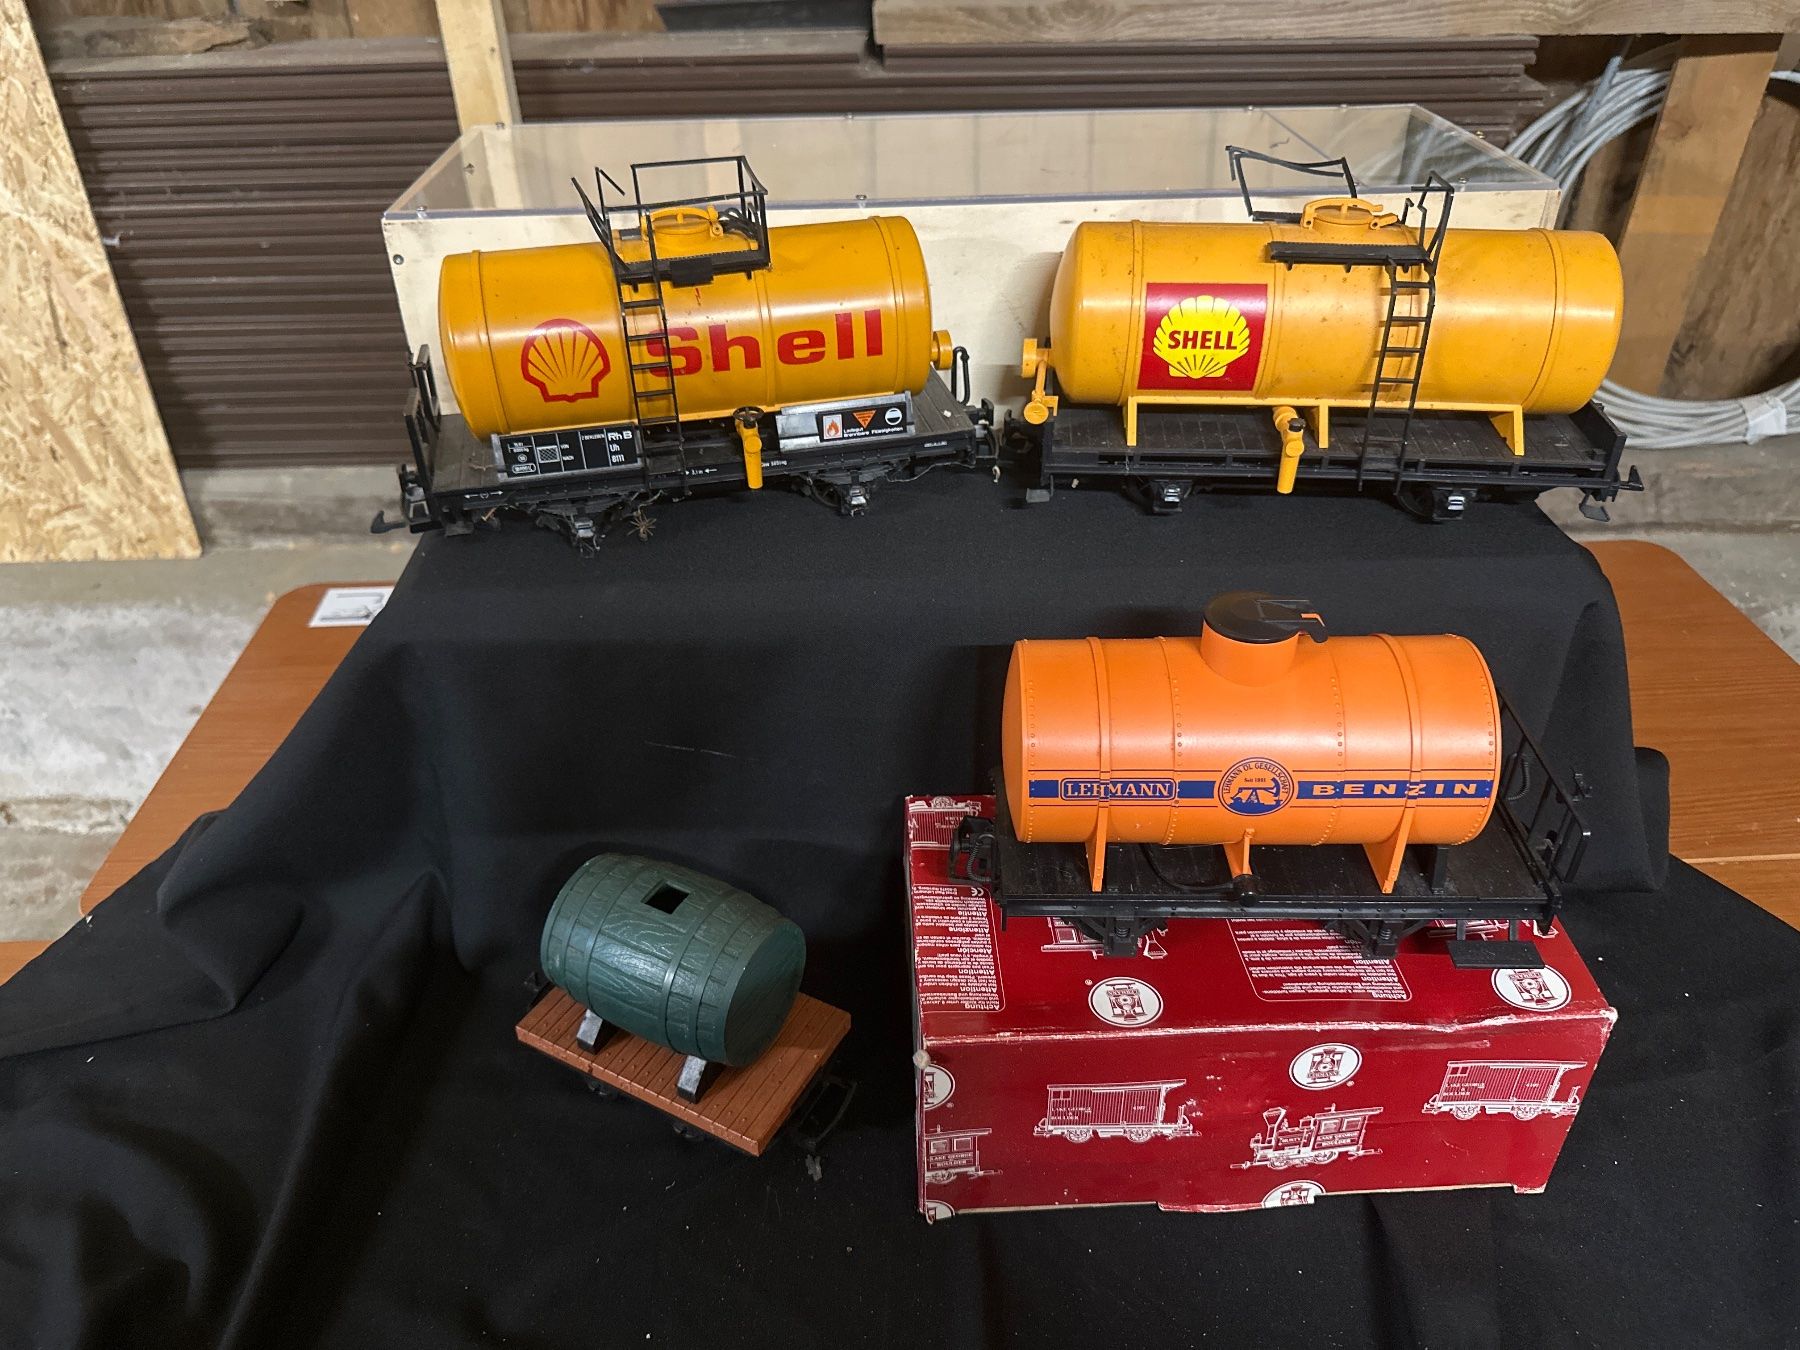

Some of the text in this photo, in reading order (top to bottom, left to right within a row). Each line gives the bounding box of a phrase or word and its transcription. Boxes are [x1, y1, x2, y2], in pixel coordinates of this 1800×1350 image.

[646, 308, 883, 378] Shell
[1167, 329, 1238, 350] SHELL
[1224, 769, 1243, 794] LEHMANN
[1254, 762, 1289, 794] GESELLSCHAFT
[1065, 782, 1171, 798] LEHMANN
[1312, 783, 1478, 797] BENZIN
